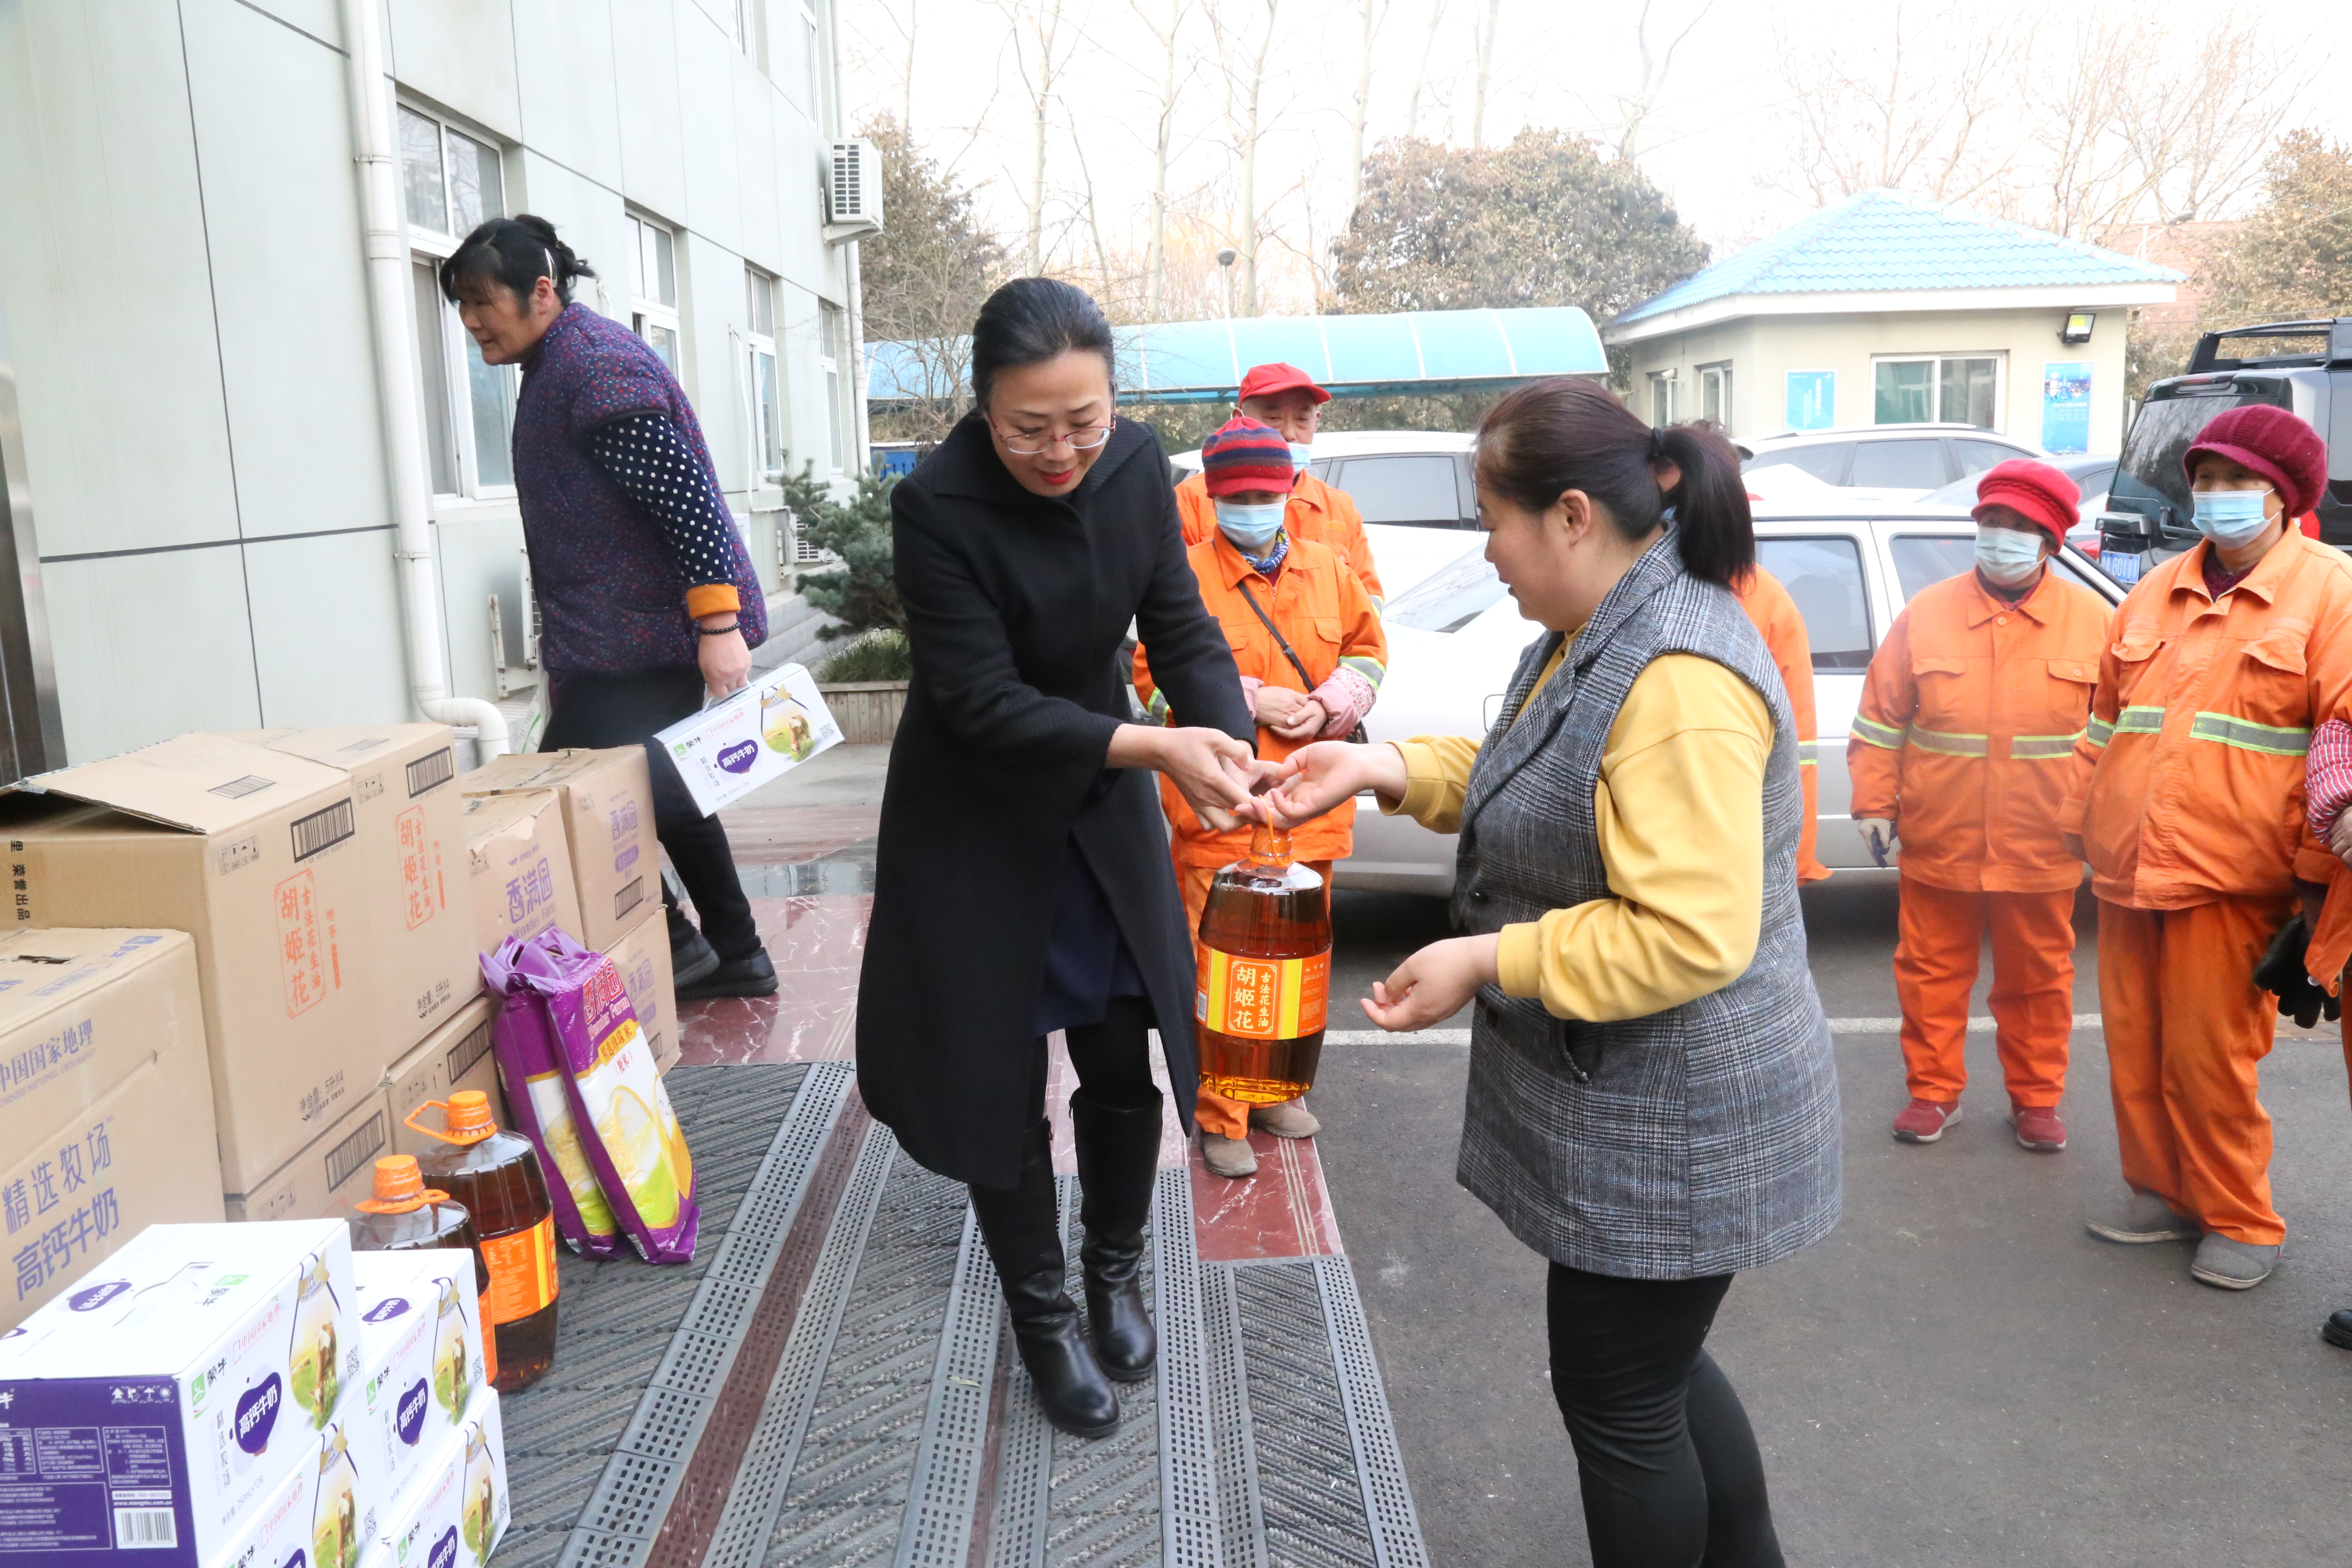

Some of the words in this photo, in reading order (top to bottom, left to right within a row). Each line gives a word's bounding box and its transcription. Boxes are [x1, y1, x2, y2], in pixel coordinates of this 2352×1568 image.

[686, 736, 702, 749] 蒙牛
[721, 744, 756, 768] 高钙牛奶
[400, 818, 423, 922] 胡姬花
[506, 857, 553, 924] 香满园
[280, 886, 310, 1009] 胡姬花
[302, 885, 321, 990] 古法花生油
[583, 957, 624, 1025] 香满园
[587, 1011, 610, 1041] Wonder
[609, 996, 631, 1019] Farm
[1233, 966, 1256, 1029] 胡姬花
[1258, 972, 1272, 1027] 古法花生油
[0, 1019, 94, 1092] 中国国家地理
[2, 1122, 111, 1236] 精选牧场
[12, 1186, 119, 1301] 高钙牛奶
[207, 1357, 227, 1388] 蒙牛
[239, 1384, 278, 1439] 高钙牛奶
[399, 1387, 426, 1432] 高钙牛奶
[217, 1407, 231, 1489] 精选牧场
